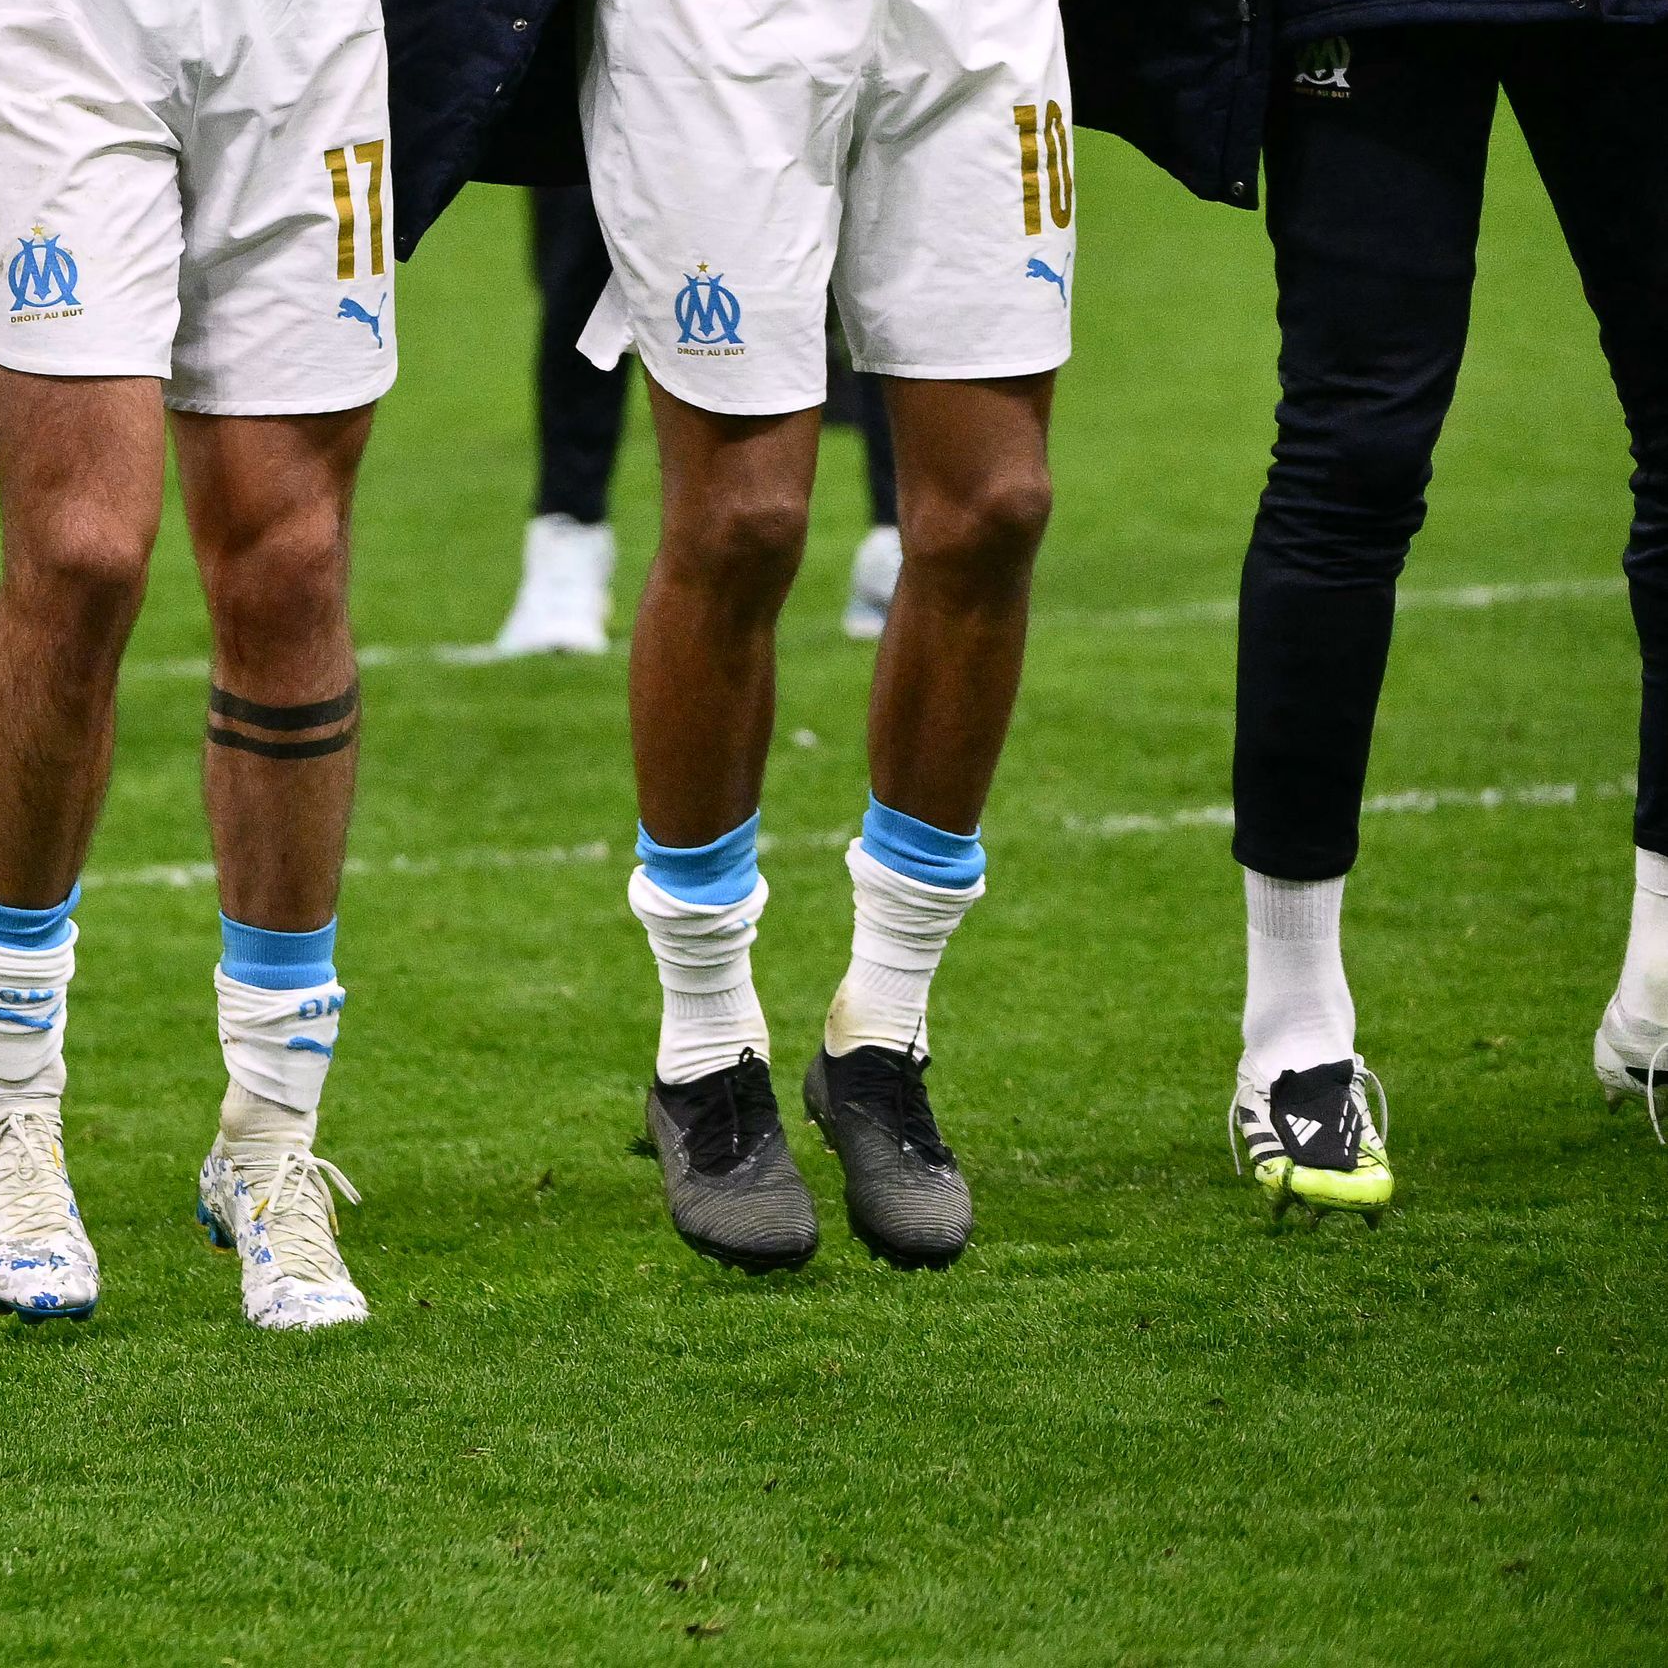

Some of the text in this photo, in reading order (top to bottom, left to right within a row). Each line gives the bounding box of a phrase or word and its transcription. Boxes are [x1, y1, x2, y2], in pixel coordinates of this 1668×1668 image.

[1013, 99, 1073, 236] 10
[325, 139, 385, 280] 17
[10, 308, 84, 323] DROIT AU BUT
[677, 347, 705, 356] DROIT
[724, 348, 745, 356] BUT
